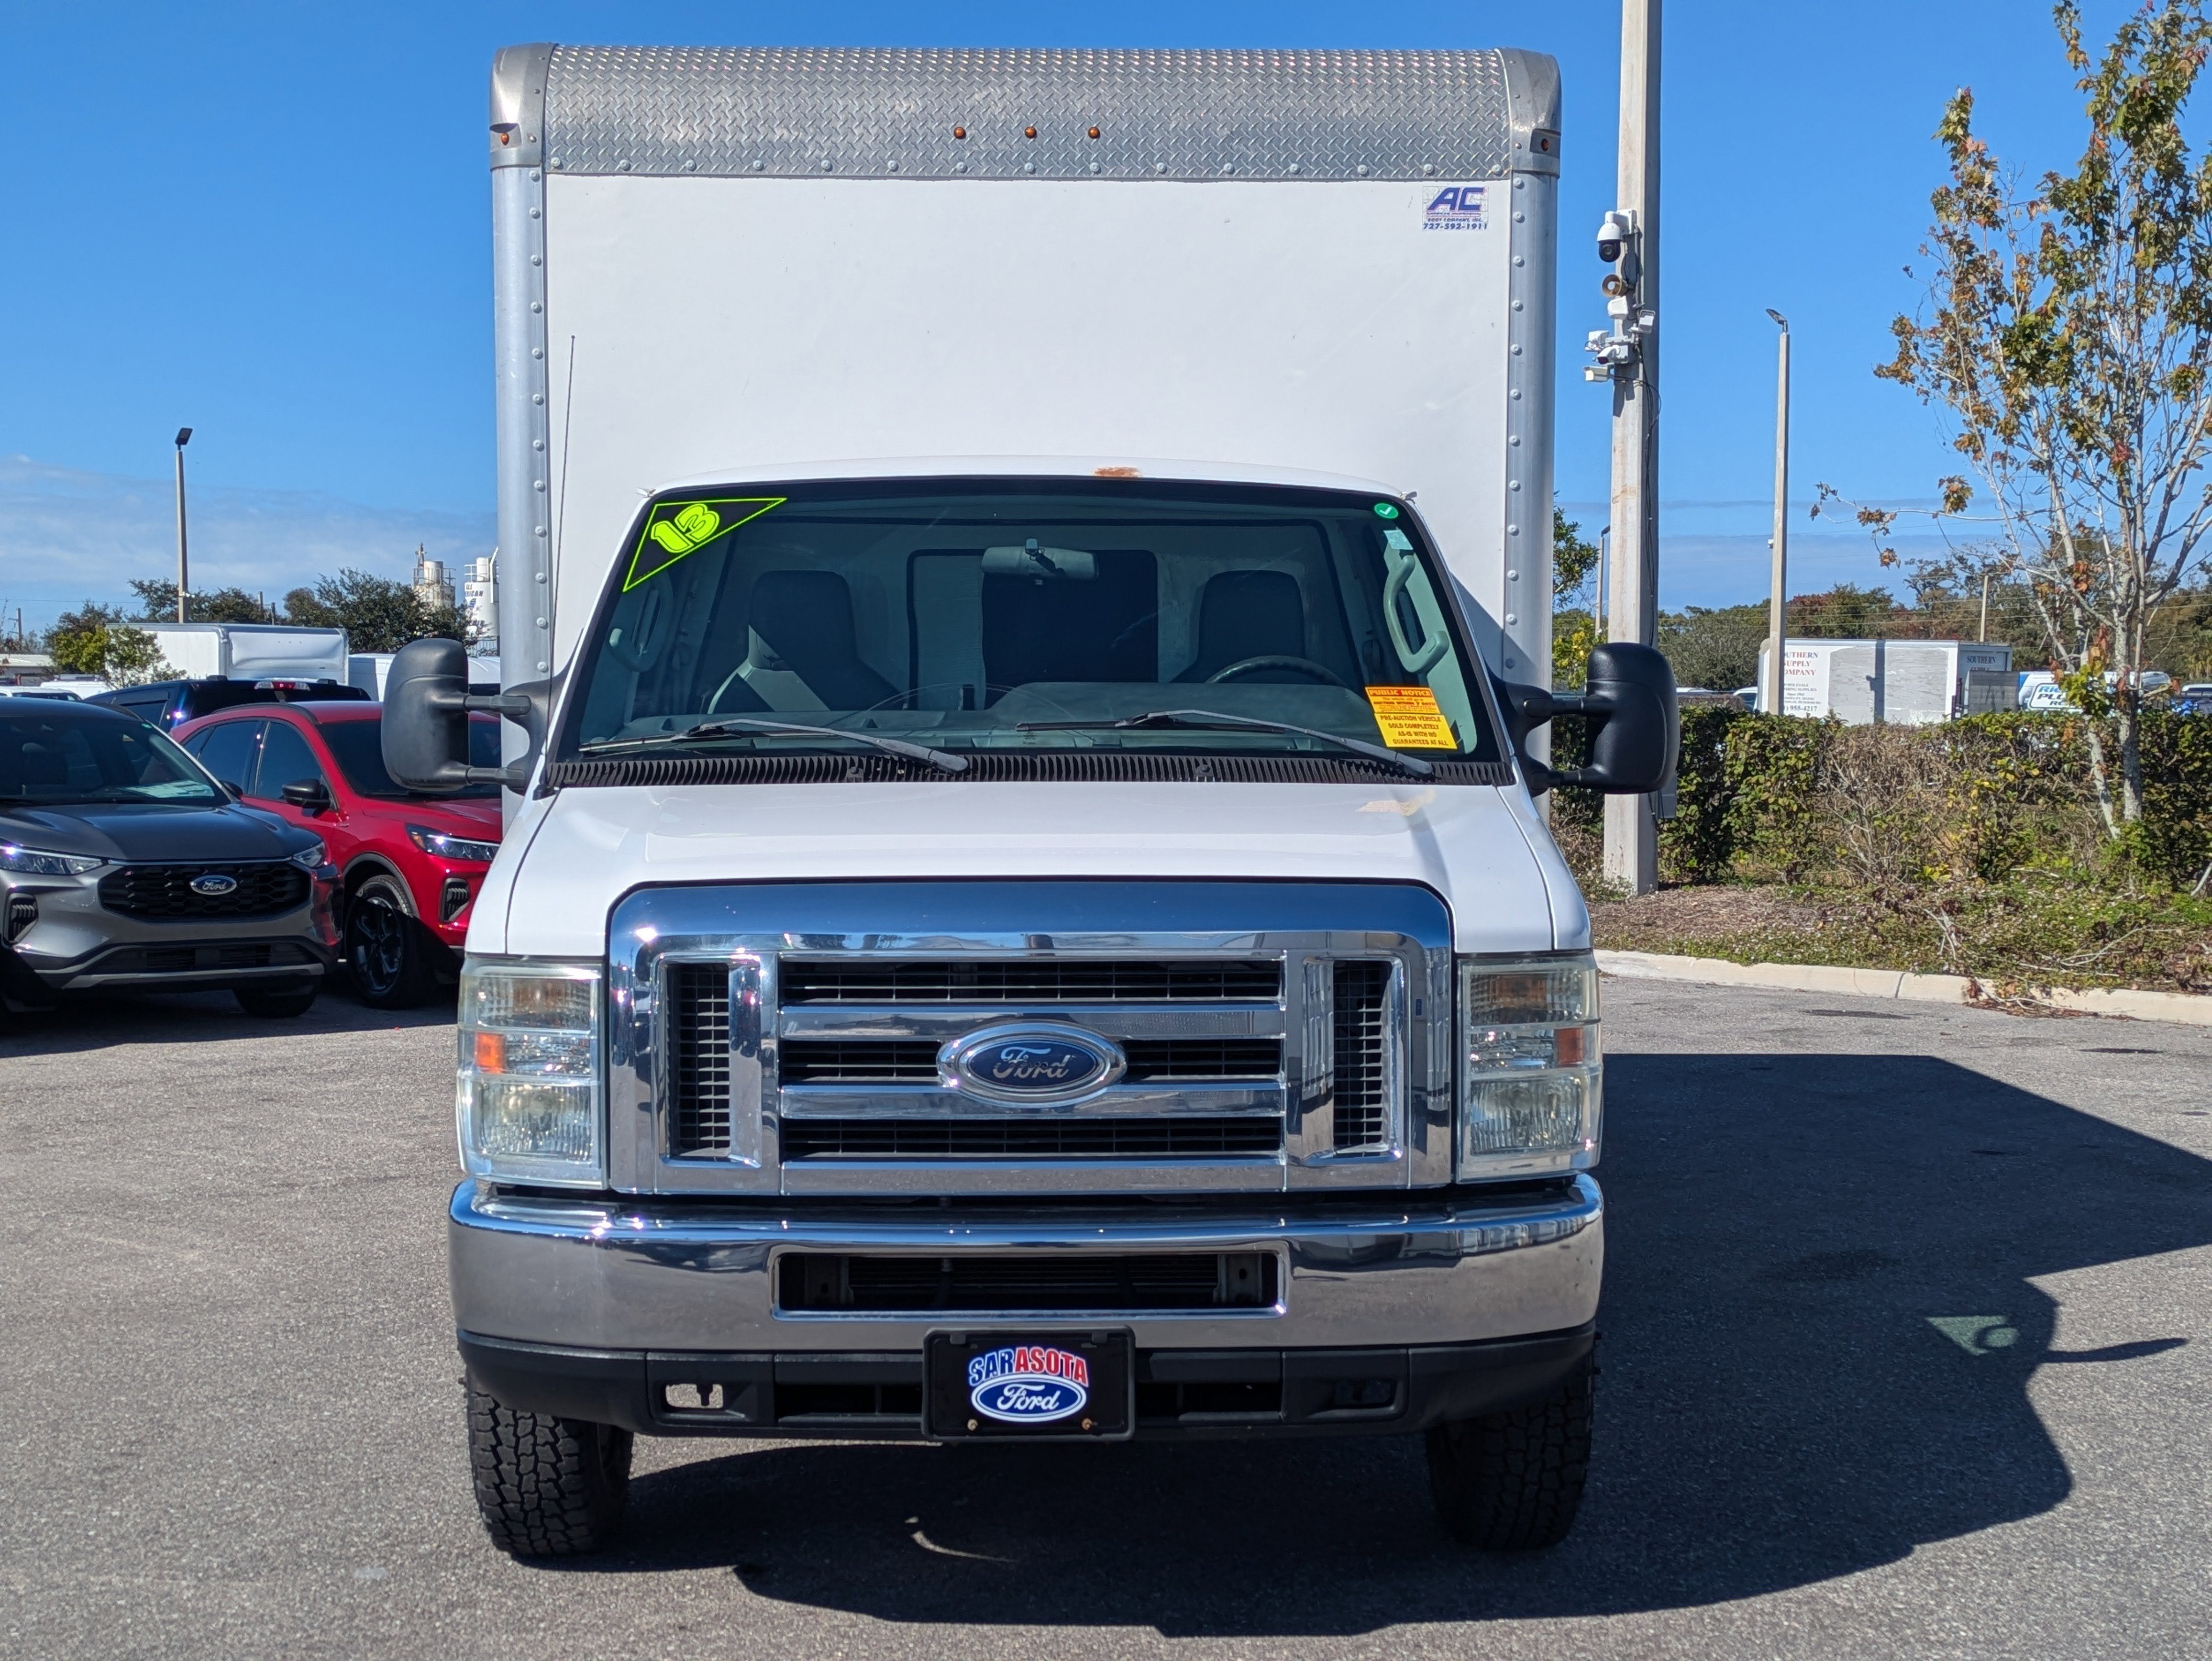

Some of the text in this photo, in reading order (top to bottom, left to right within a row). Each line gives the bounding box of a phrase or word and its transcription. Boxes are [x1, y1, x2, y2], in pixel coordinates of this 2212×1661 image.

[1427, 187, 1485, 210] AC
[651, 503, 719, 553] 13
[1966, 655, 1996, 664] SOUTHERN
[202, 879, 227, 890] Ford
[992, 1046, 1071, 1079] Ford
[968, 1346, 1089, 1387] SARASOTA
[997, 1383, 1062, 1410] Ford
